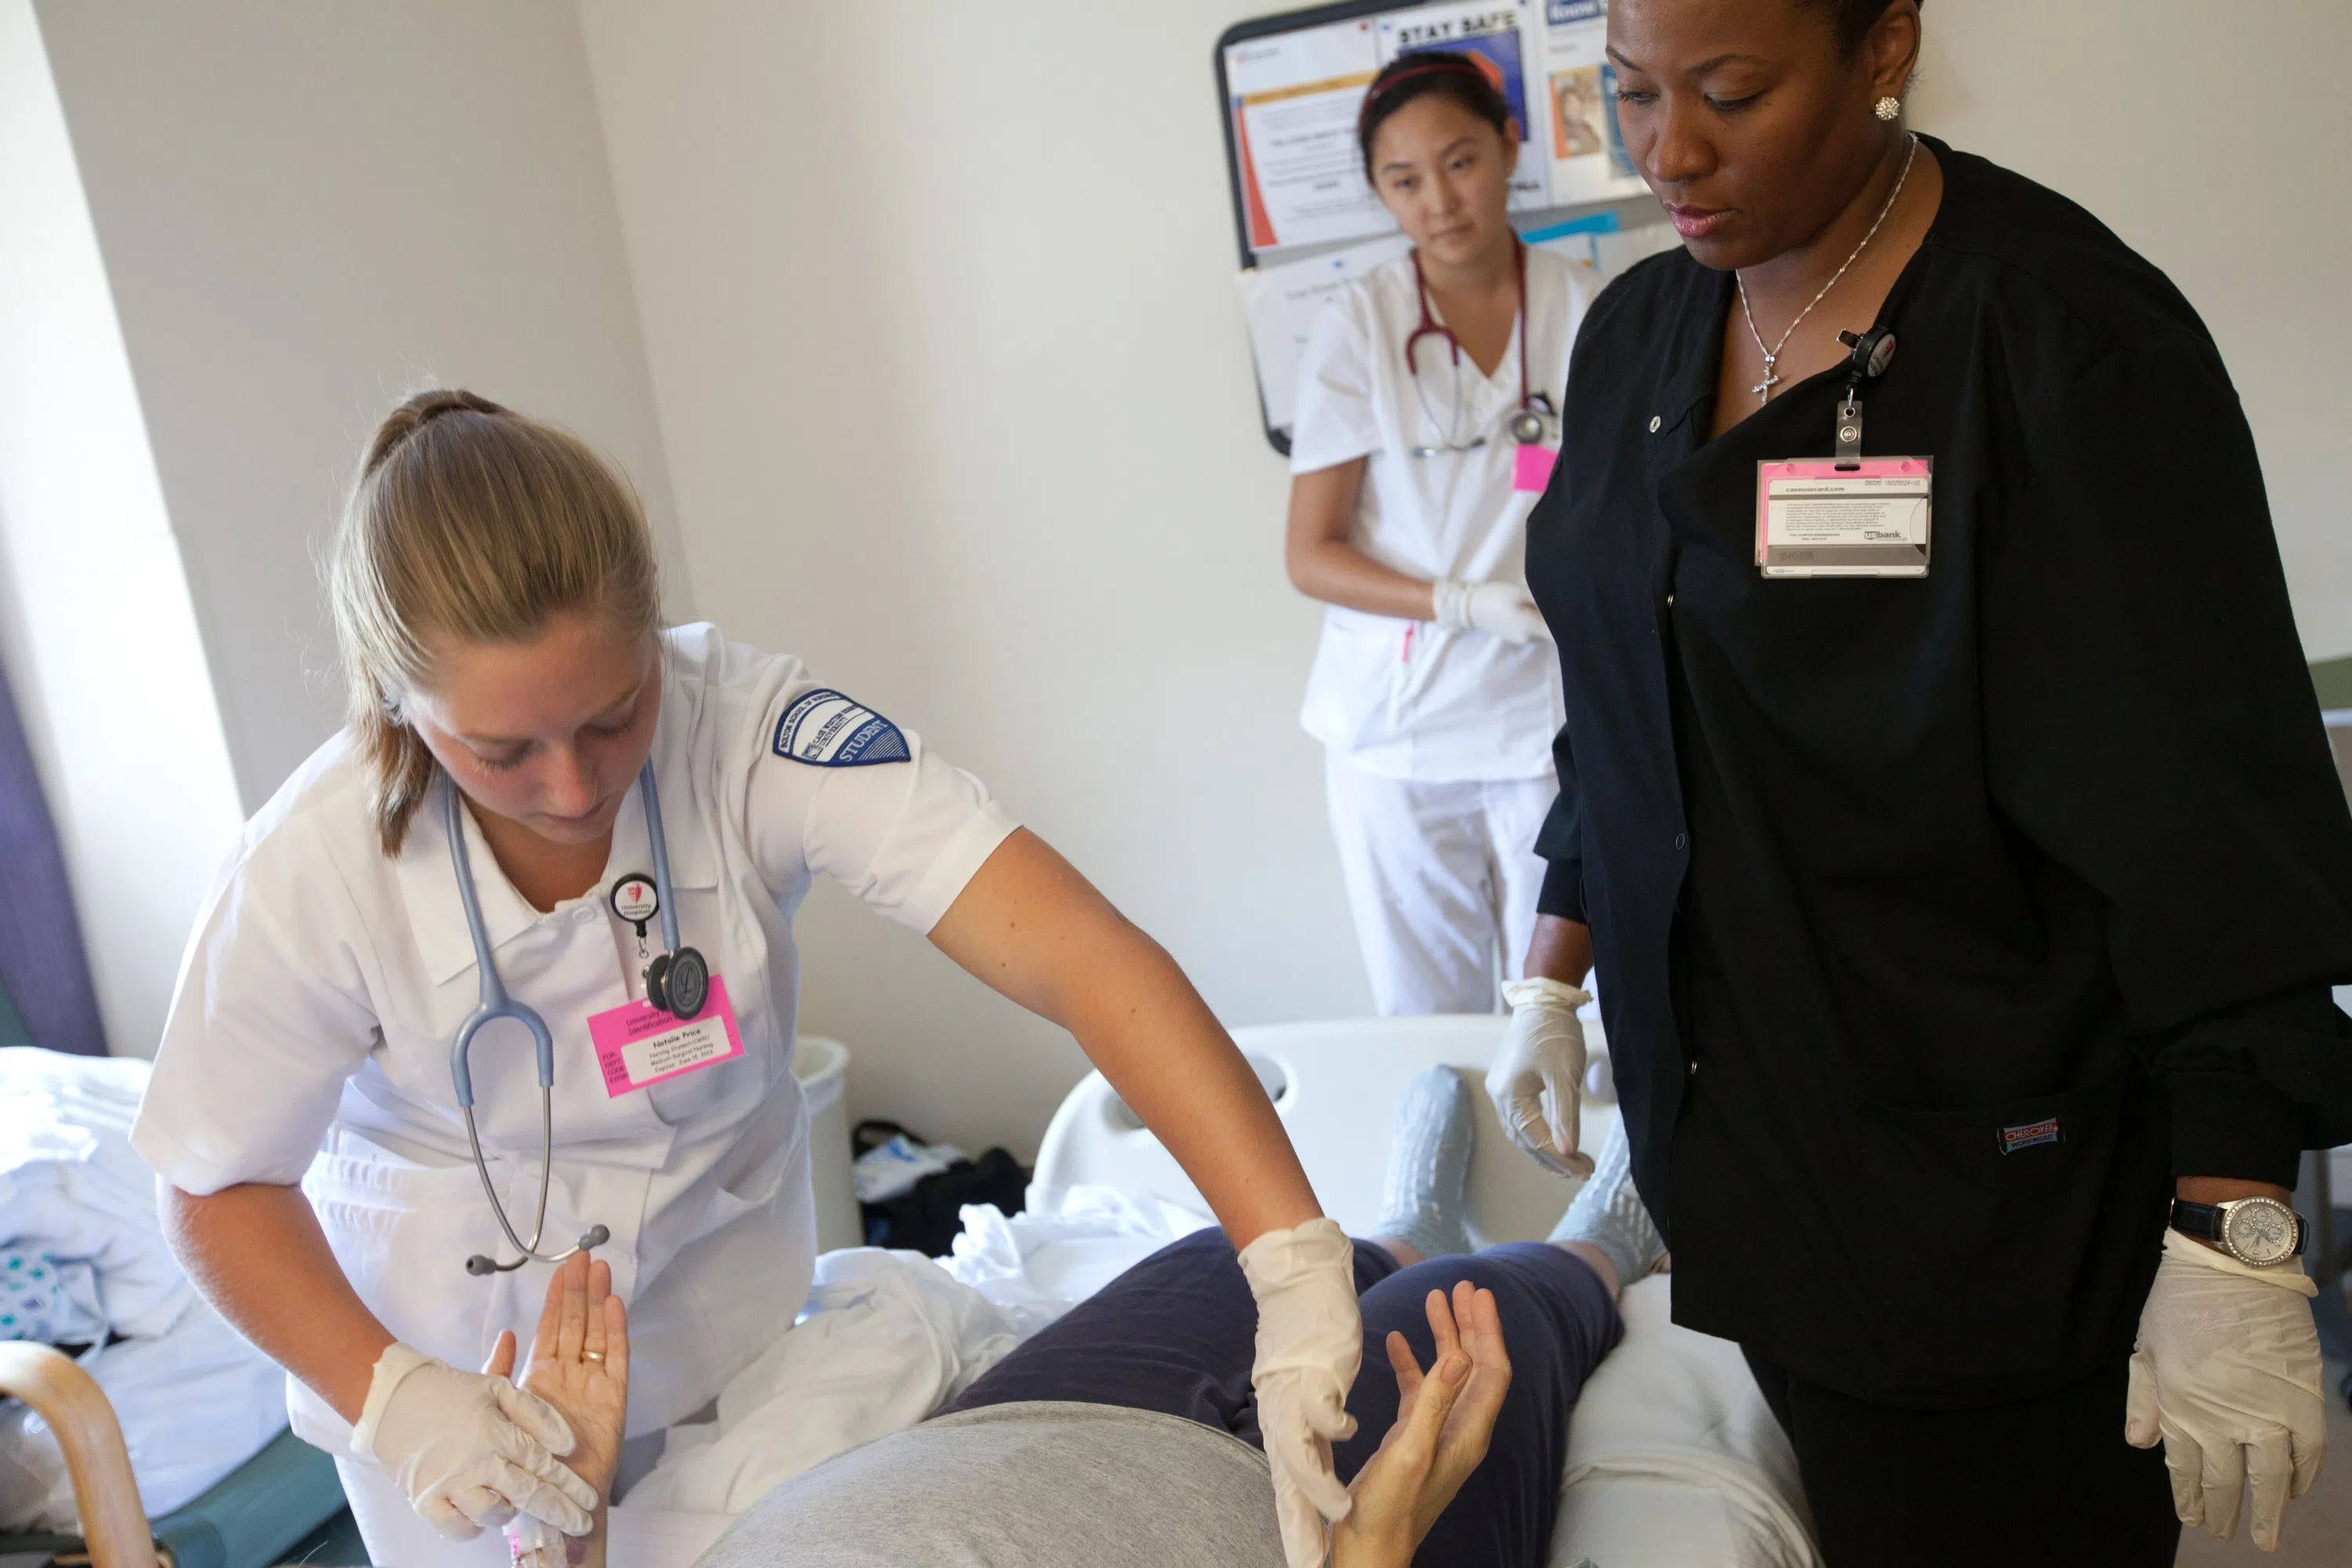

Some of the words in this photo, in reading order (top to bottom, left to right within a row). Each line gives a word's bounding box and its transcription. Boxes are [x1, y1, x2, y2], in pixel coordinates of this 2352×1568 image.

[1399, 22, 1451, 44] STAY
[1461, 9, 1516, 33] SAFE
[780, 724, 794, 748] BOLTON
[788, 705, 808, 724] SCHOOL
[812, 728, 826, 744] CASE
[818, 717, 849, 749] UNIVERSITY
[839, 720, 888, 762] STUDENT
[626, 1010, 660, 1025] University
[628, 1016, 673, 1036] Identification
[653, 1035, 681, 1049] Natalie
[682, 1028, 702, 1040] Price
[2005, 1123, 2054, 1141] CHEROKEE
[2011, 1134, 2053, 1148] WORKWEAR
